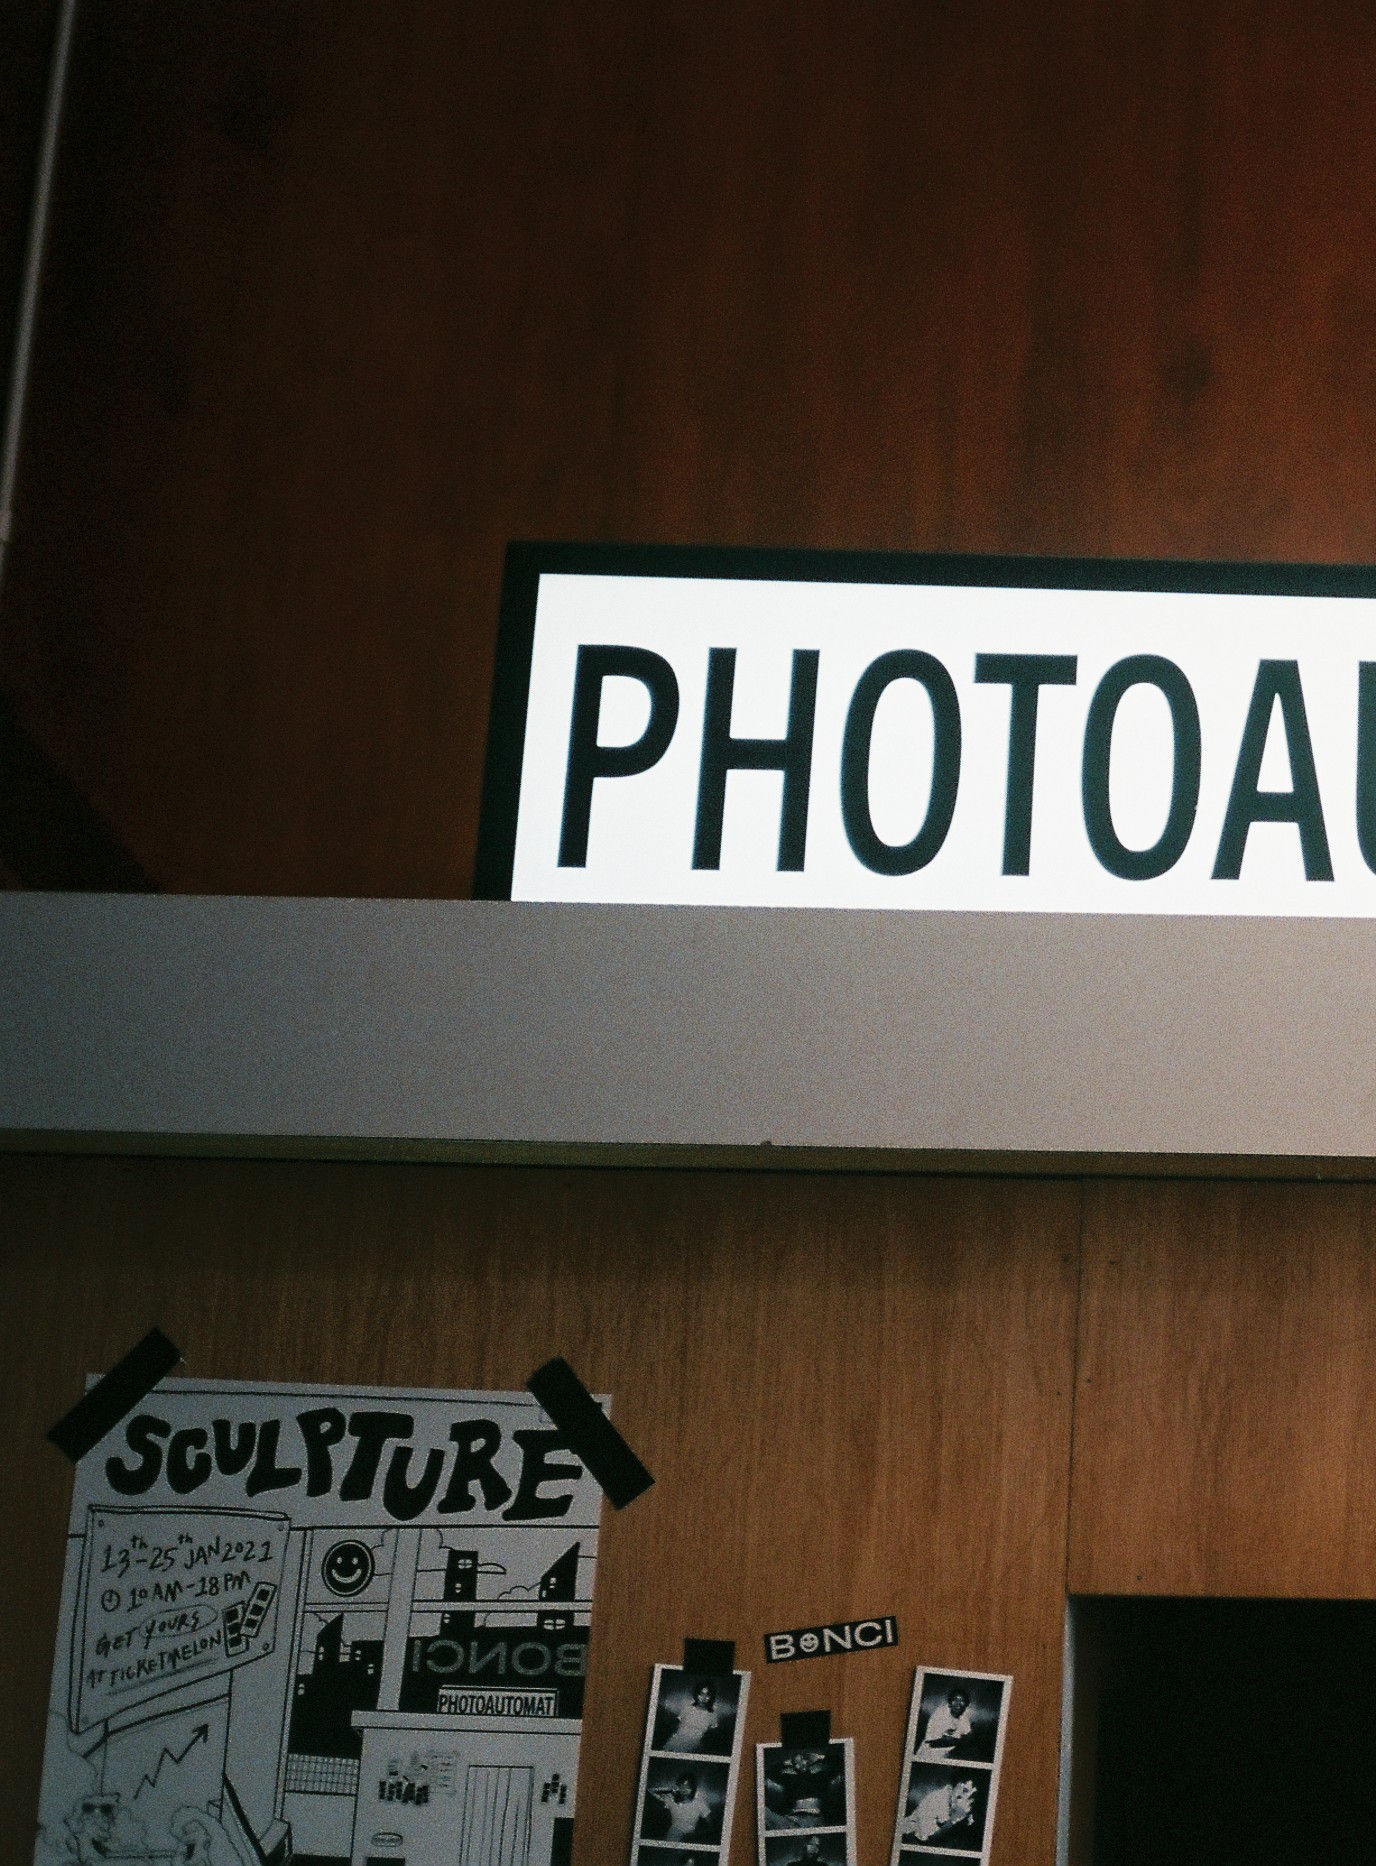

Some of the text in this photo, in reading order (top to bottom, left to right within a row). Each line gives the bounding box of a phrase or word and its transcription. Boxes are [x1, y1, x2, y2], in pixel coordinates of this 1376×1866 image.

[106, 1407, 583, 1520] SCULPTURE
[221, 1541, 273, 1563] 2021
[96, 1610, 201, 1657] GET YOURS
[110, 1629, 223, 1687] TICKETMELON
[439, 1694, 554, 1716] PHOTOAUTOMAT
